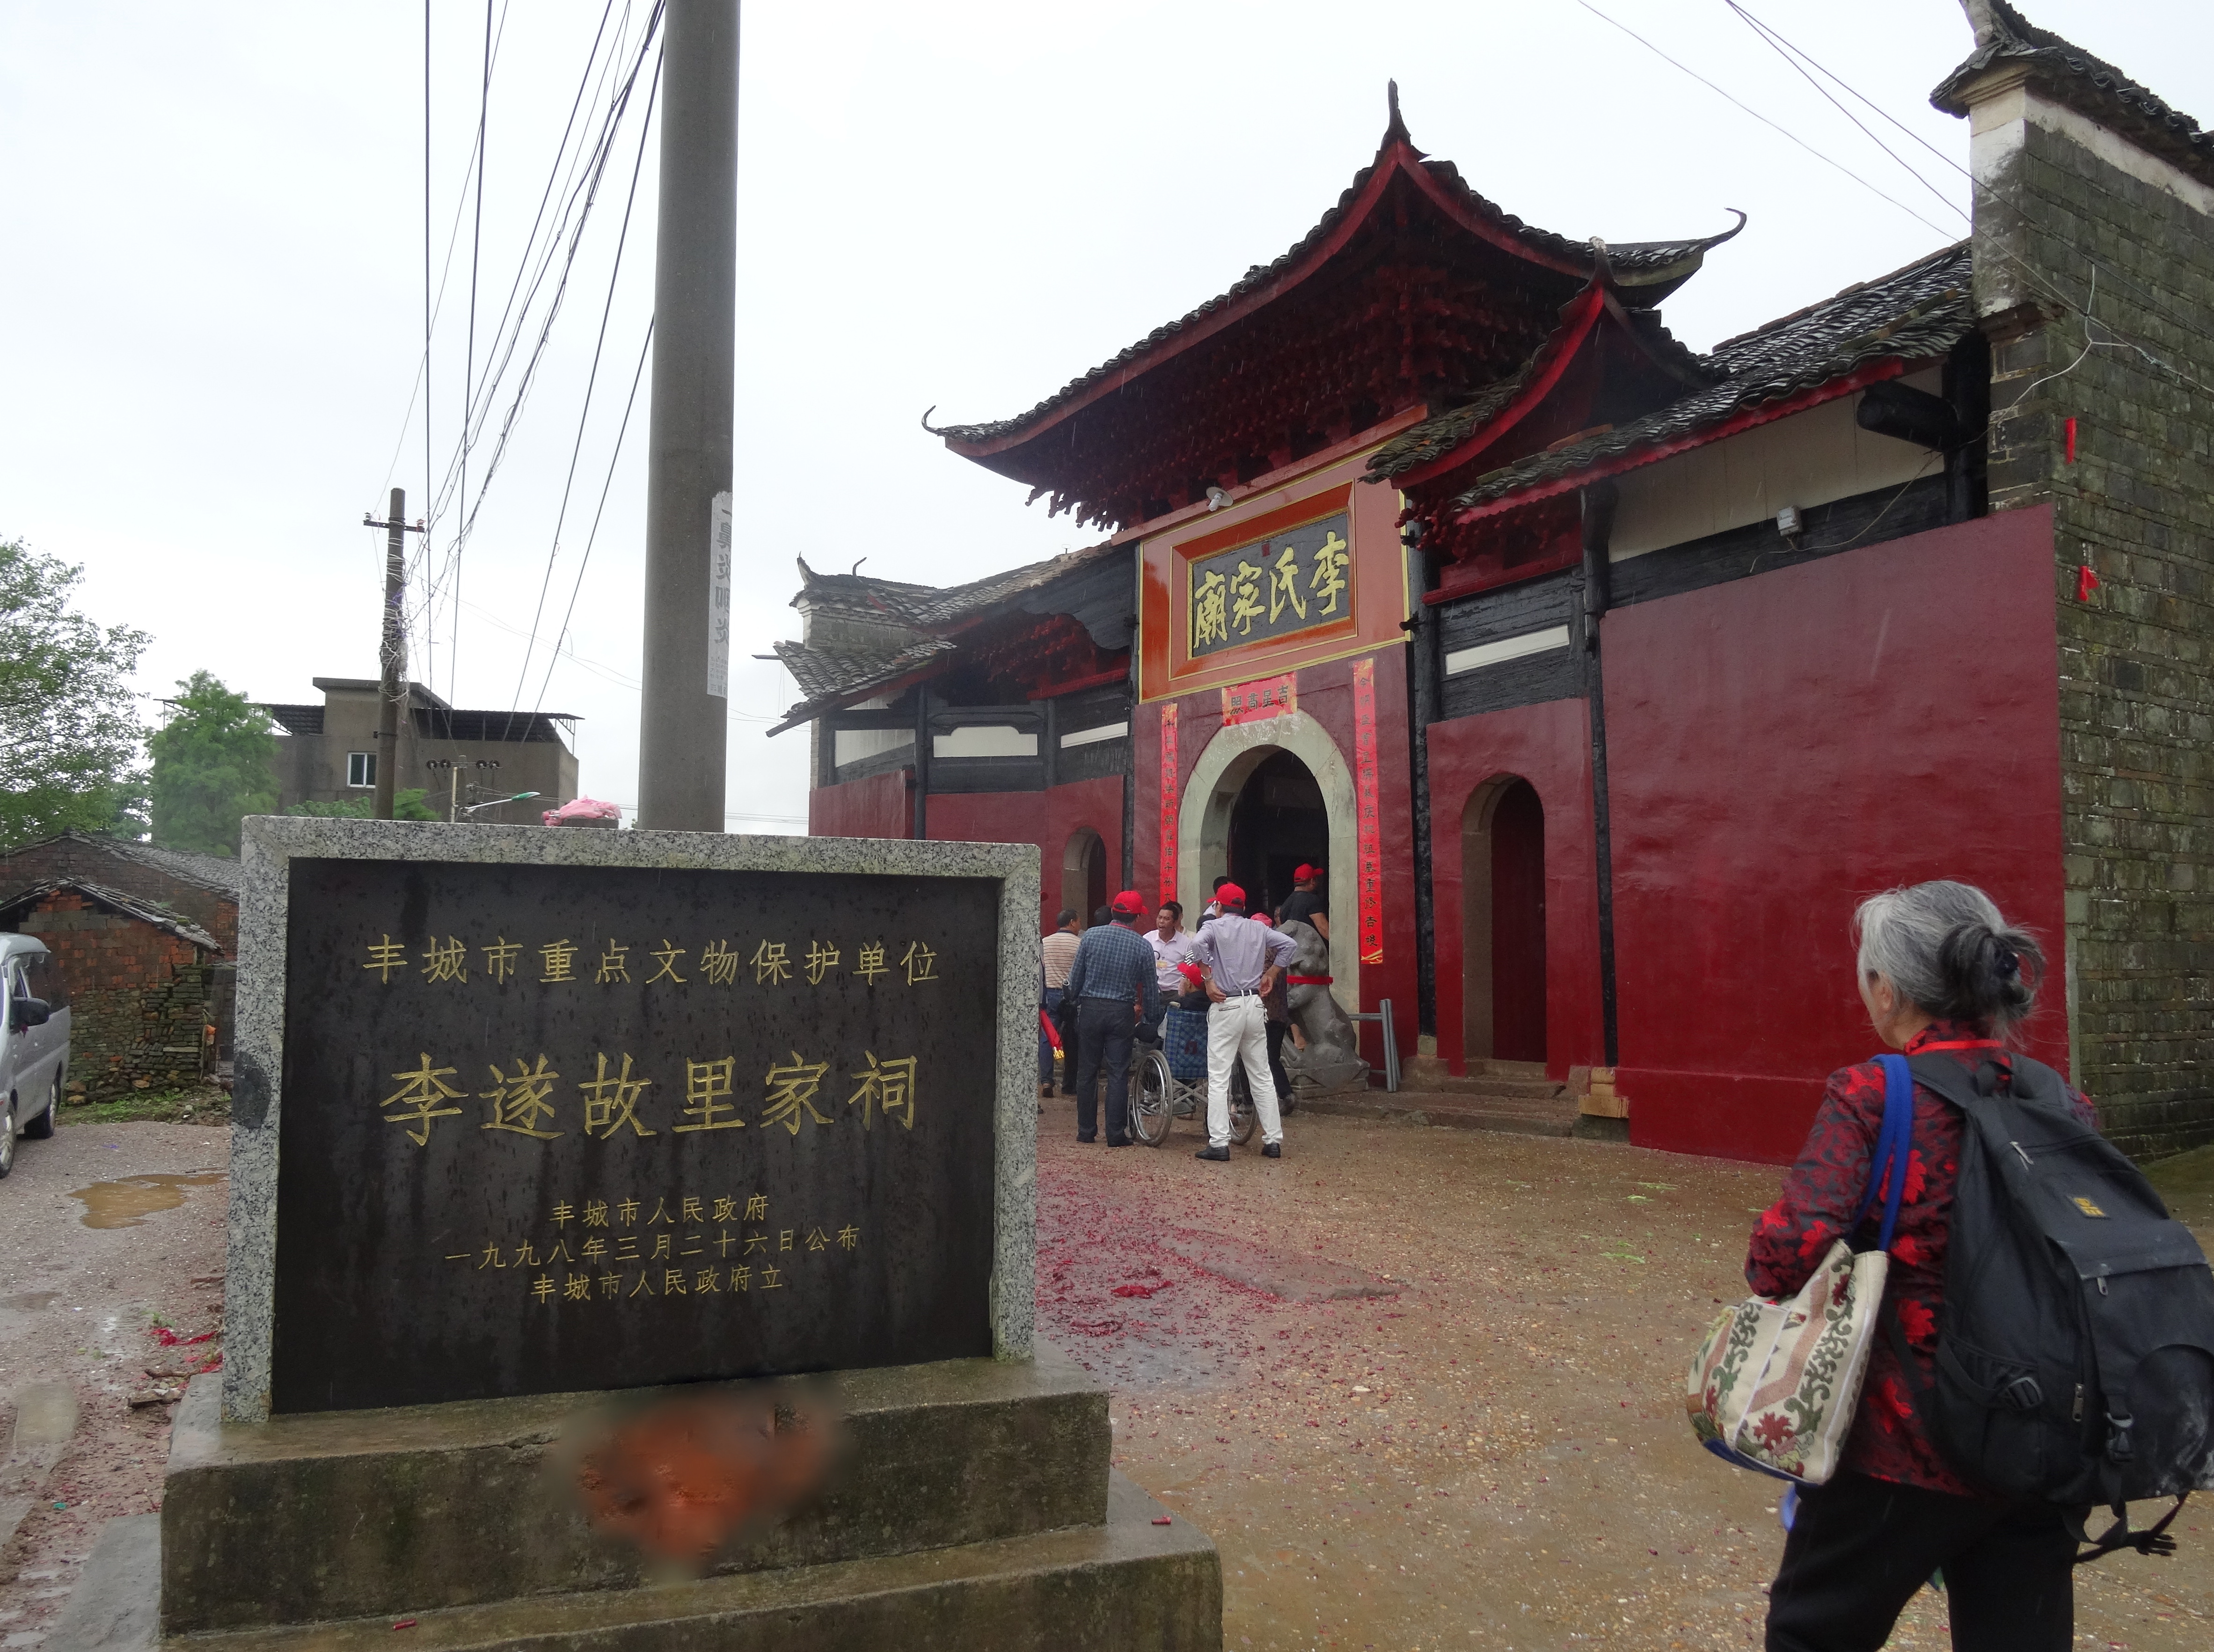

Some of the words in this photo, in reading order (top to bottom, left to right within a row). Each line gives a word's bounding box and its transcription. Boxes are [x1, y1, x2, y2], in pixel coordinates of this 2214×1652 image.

[1230, 684, 1289, 715] 吉星高照
[363, 934, 939, 988] 丰城市重点文物保护单位
[380, 1051, 918, 1146] 李遂故里家祠
[549, 1193, 769, 1227] 丰城市人民政府
[445, 1223, 859, 1272] 一九九八年三月二十六日公布
[531, 1264, 783, 1303] 丰城市人民政府立
